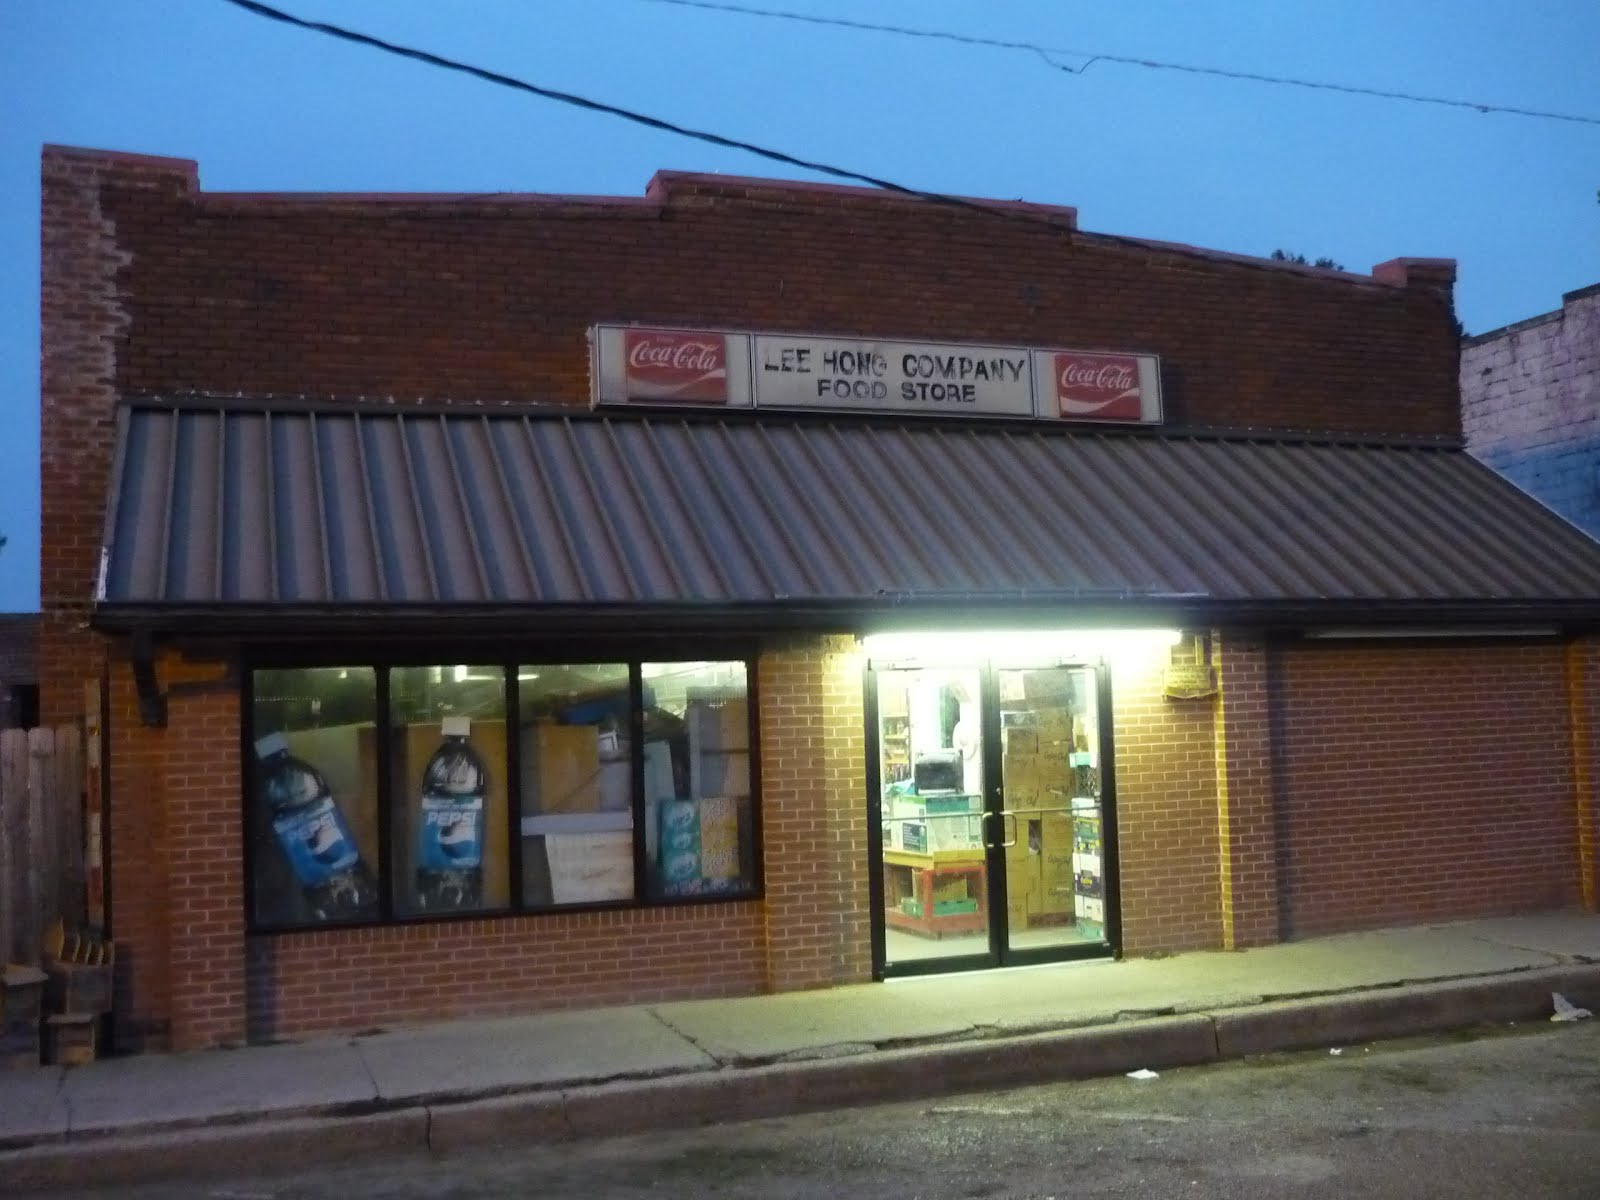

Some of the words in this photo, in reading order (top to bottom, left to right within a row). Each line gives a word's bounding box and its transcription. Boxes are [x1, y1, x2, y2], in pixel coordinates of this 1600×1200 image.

[764, 348, 811, 373] LEE
[823, 350, 887, 377] HONG
[902, 354, 1025, 382] COMPANY
[817, 378, 887, 399] FOOD
[901, 381, 976, 402] STORE
[426, 811, 477, 826] PEPSI
